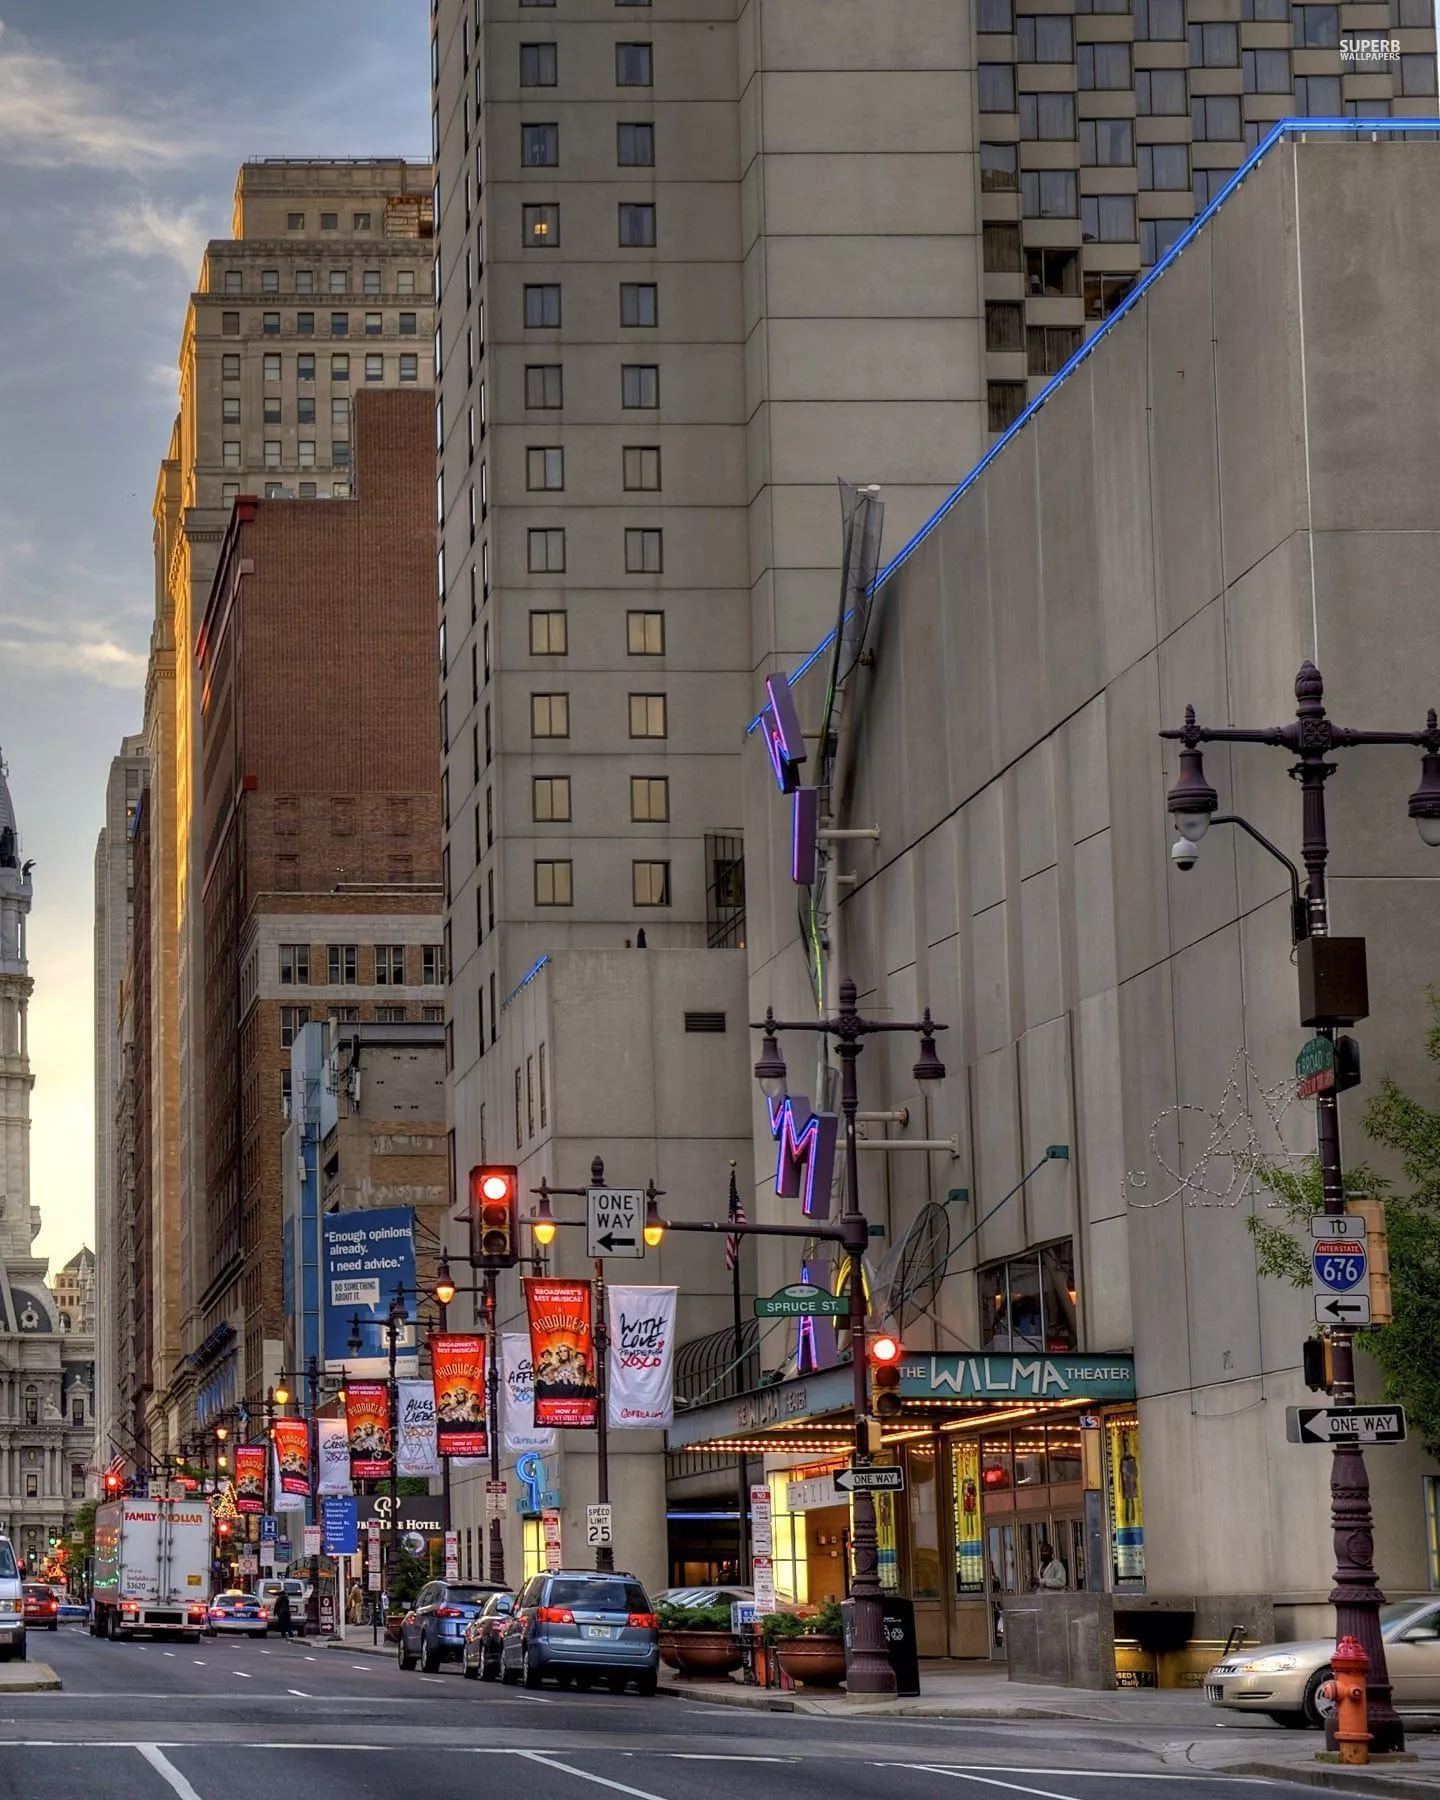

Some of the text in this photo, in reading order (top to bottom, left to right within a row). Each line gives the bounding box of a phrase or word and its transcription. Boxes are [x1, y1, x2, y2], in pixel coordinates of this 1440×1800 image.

[598, 1195, 633, 1210] ONE
[597, 1213, 634, 1228] WAY
[1329, 1220, 1347, 1234] TO
[369, 1227, 412, 1241] opinions
[330, 1243, 368, 1256] already.
[1319, 1244, 1359, 1252] INTERSTATE
[330, 1261, 334, 1272] I
[337, 1259, 362, 1271] need
[1323, 1258, 1358, 1281] 676
[334, 1281, 376, 1292] DO SOMETHING
[334, 1292, 353, 1301] ABOUT
[766, 1301, 839, 1312] SPRUCE ST.
[532, 1314, 590, 1335] PRODUCERS
[620, 1313, 667, 1334] WITH
[621, 1332, 663, 1348] LOVE
[620, 1355, 662, 1370] XOXO
[436, 1362, 483, 1380] PRODUCERS
[508, 1371, 535, 1384] AFFE
[899, 1356, 1130, 1395] THE WILMA THEATER
[406, 1399, 433, 1411] ALLES
[404, 1411, 436, 1422] LIEBE
[1331, 1416, 1392, 1432] ONE WAY
[854, 1474, 894, 1484] ONE WAY
[125, 1512, 203, 1523] FAMILY DOLLAR
[588, 1508, 610, 1516] SPEED
[264, 1521, 275, 1532] H
[406, 1519, 441, 1530] HOTEL
[589, 1526, 611, 1541] 25
